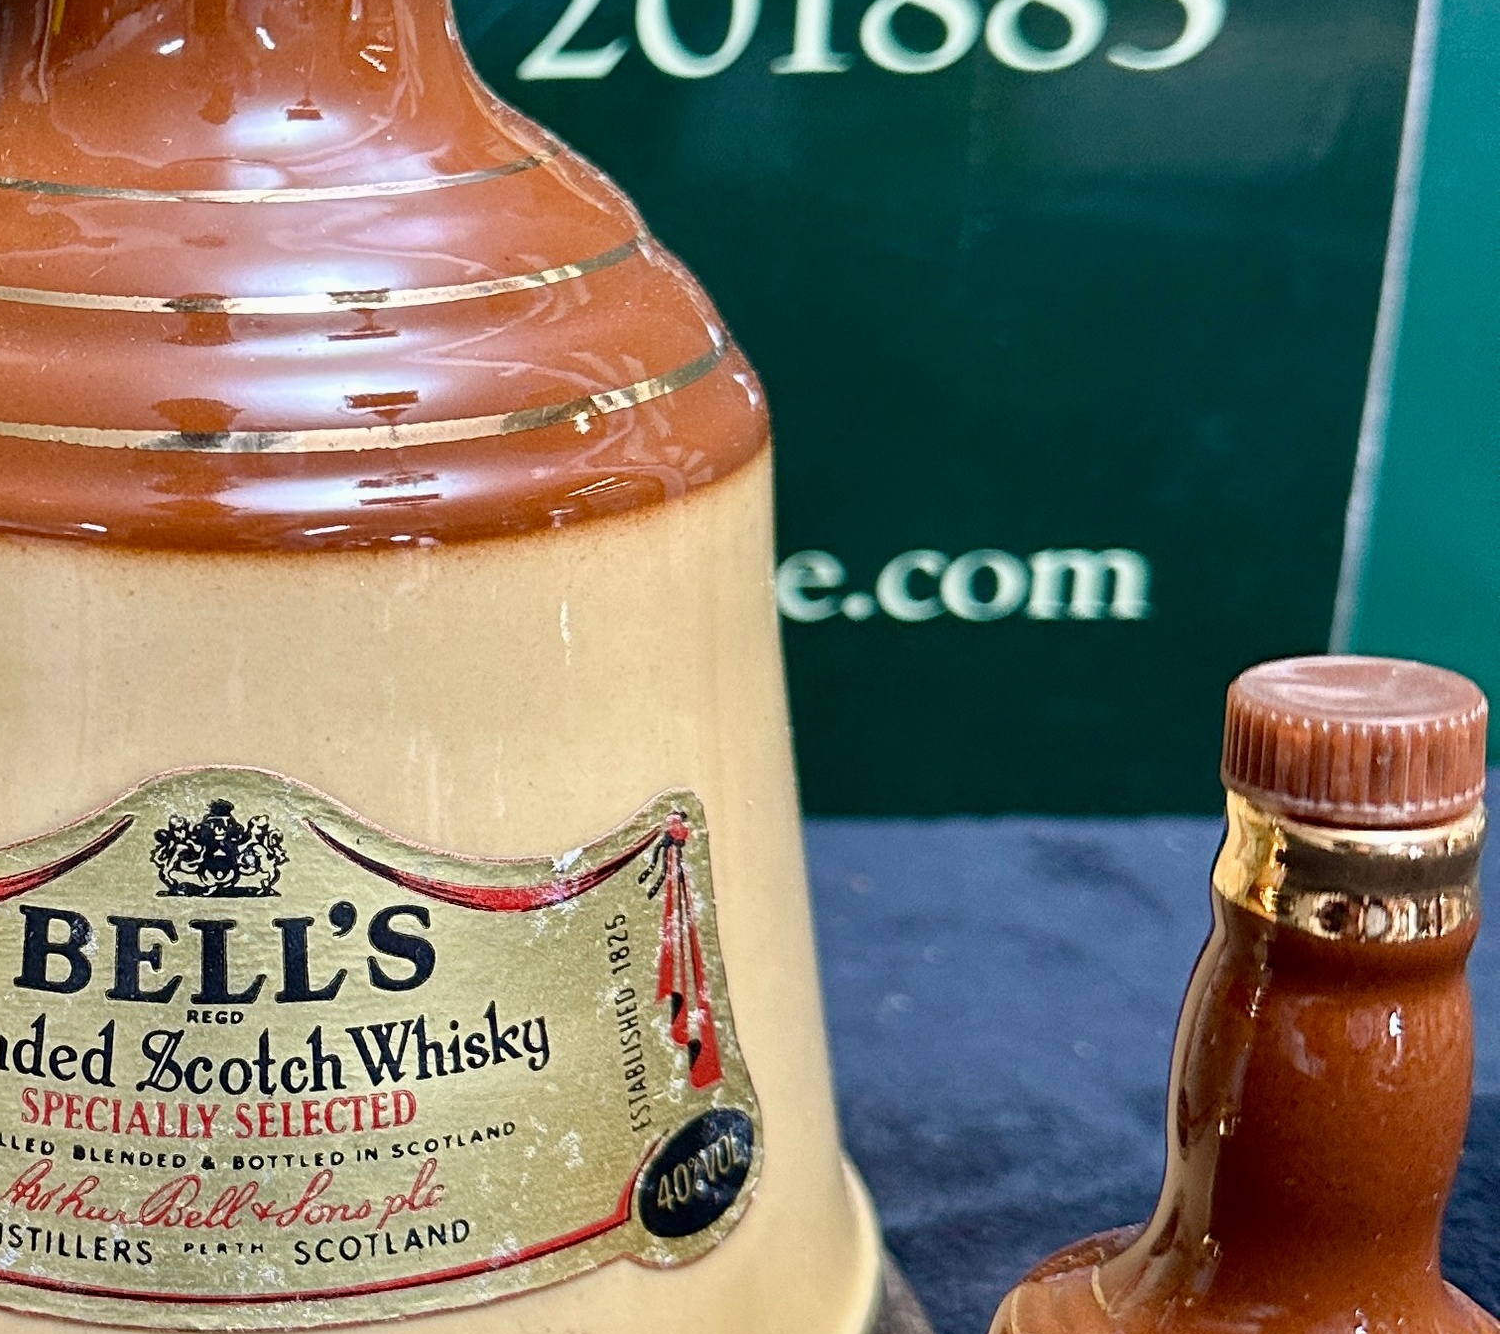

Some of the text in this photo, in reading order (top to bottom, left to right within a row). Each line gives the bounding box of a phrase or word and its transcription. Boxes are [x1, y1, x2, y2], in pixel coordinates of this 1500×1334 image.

[12, 900, 437, 1005] BELL'S
[186, 1008, 245, 1025] REGD
[604, 914, 652, 1133] ESTABLISHED 1825
[135, 1024, 348, 1095] Scotch
[345, 1000, 551, 1087] Whisky
[20, 1087, 417, 1140] SPECIALLY SELECTED
[72, 1144, 187, 1169] BLENDED
[232, 1150, 345, 1170] BOTTLED
[356, 1147, 379, 1163] IN
[391, 1120, 517, 1159] SCOTLAND
[138, 1173, 259, 1230] Bell
[275, 1168, 372, 1229] Sons
[294, 1218, 471, 1266] SCOTLAND
